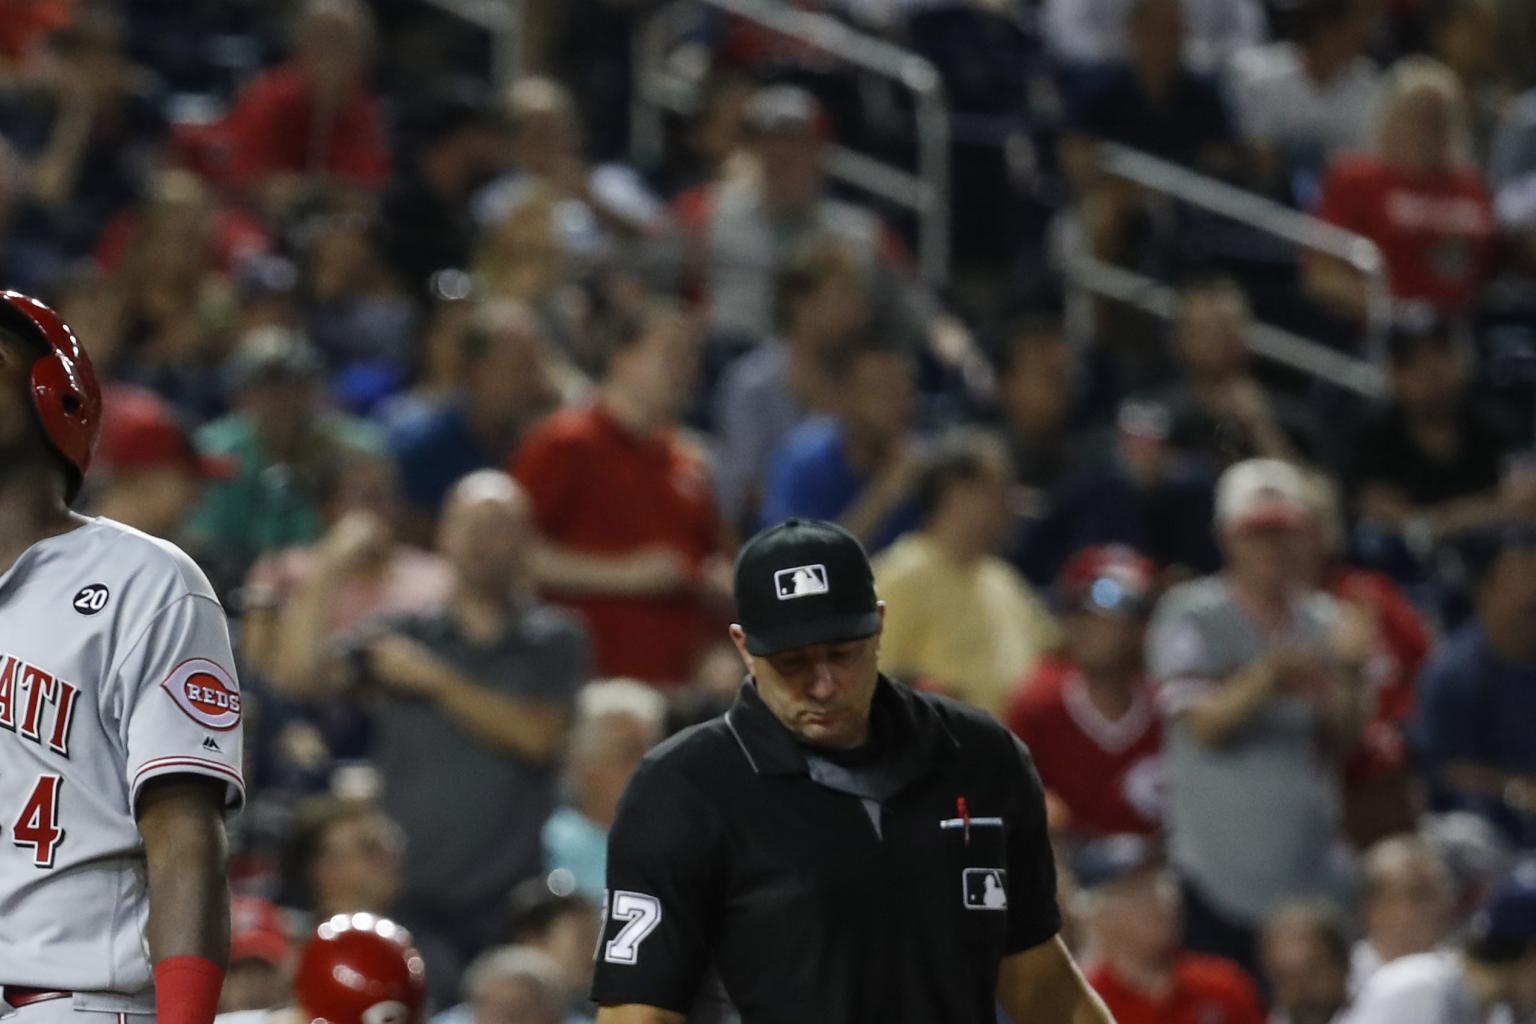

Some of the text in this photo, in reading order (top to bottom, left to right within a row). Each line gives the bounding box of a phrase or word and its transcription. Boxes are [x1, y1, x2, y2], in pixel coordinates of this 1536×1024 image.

[75, 588, 108, 610] 20
[186, 682, 240, 712] REDS
[592, 888, 662, 965] 7
